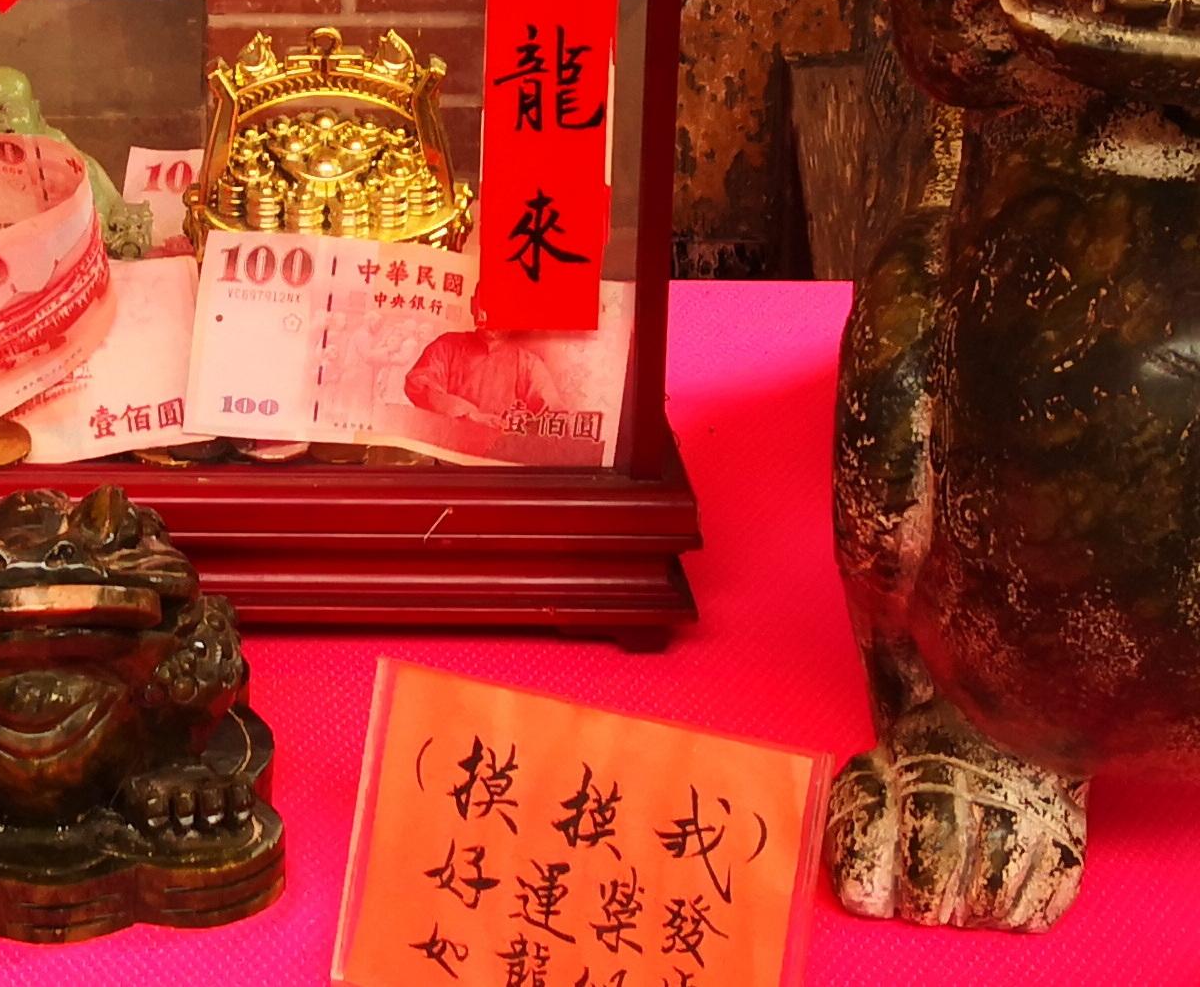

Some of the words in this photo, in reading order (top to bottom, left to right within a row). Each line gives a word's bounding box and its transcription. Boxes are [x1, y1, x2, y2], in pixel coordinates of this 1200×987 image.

[144, 159, 201, 194] 10
[216, 243, 315, 288] 100
[358, 259, 464, 297] 中華民國
[373, 292, 444, 315] 中央銀行
[88, 397, 185, 440] 壹佰圓
[220, 395, 279, 416] 100
[502, 399, 605, 442] 壹佰圓
[423, 839, 730, 968] 好運榮發
[409, 922, 697, 987] 如龍
